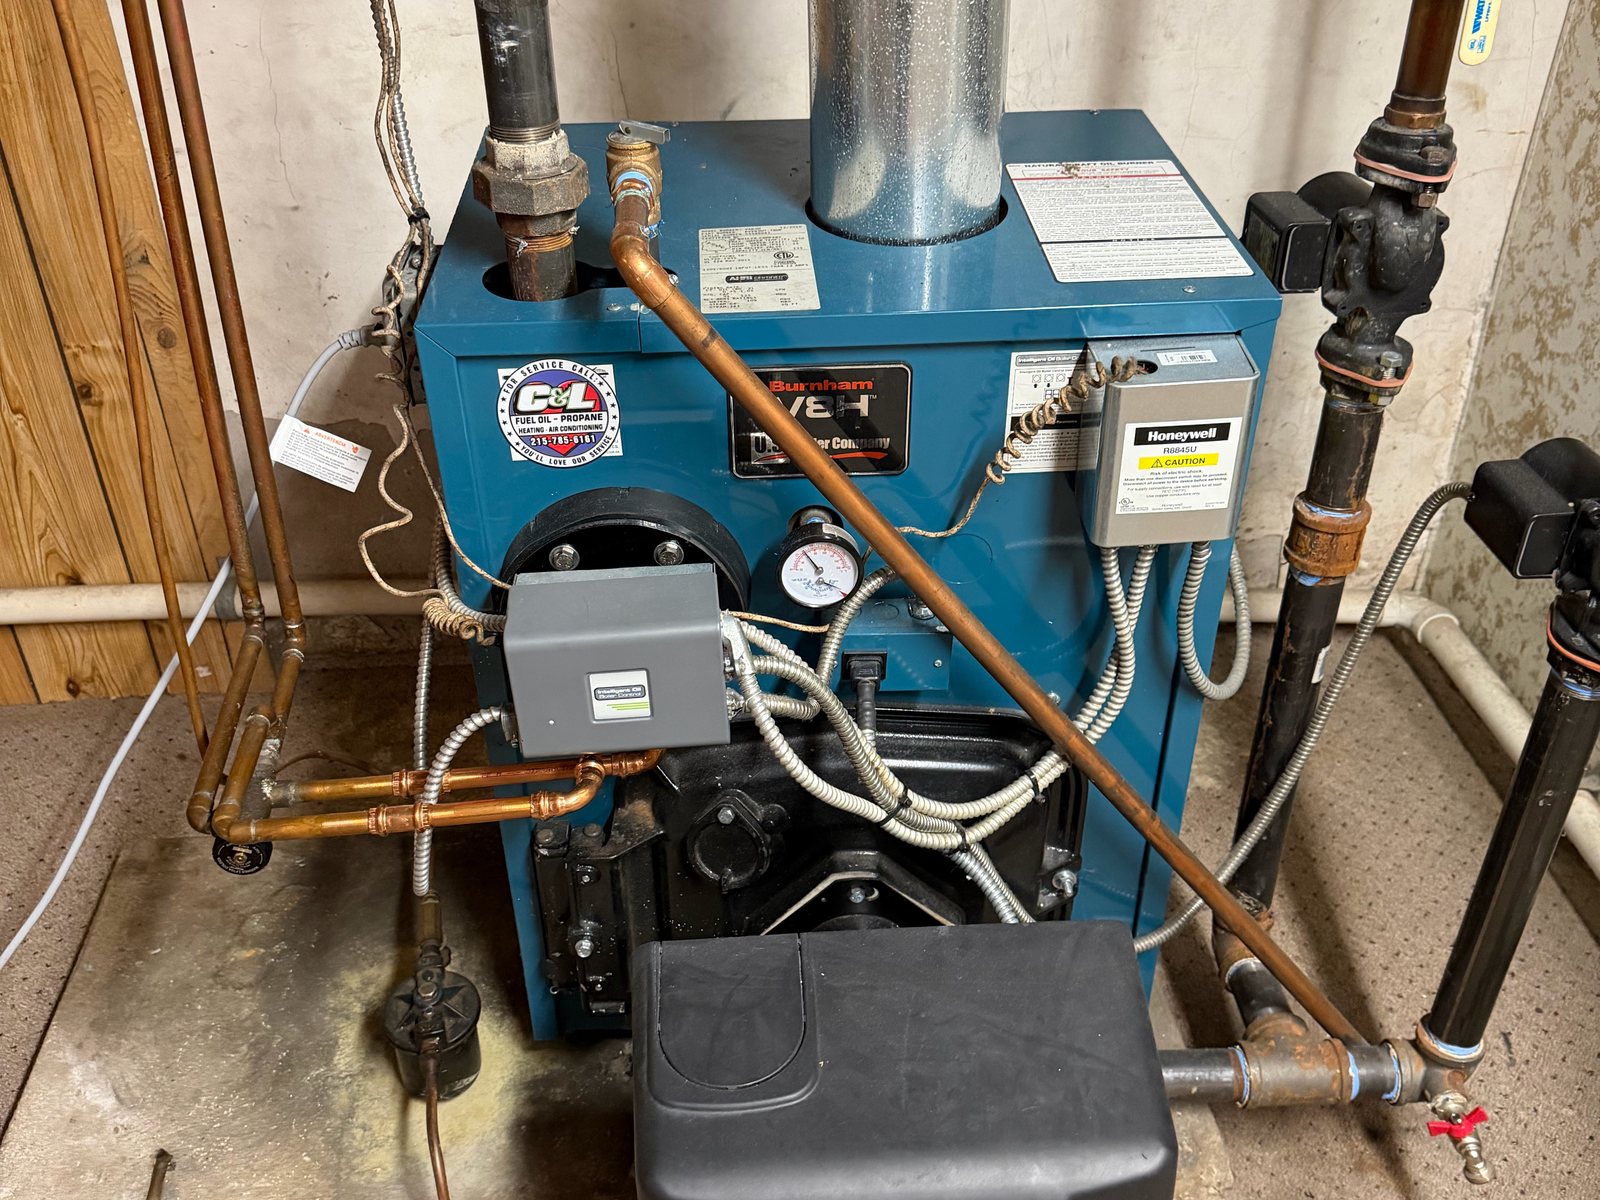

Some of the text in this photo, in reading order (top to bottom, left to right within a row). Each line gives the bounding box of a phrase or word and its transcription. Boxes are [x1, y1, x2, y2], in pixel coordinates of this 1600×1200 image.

[503, 378, 519, 394] FOR
[520, 361, 564, 377] SERVICE
[769, 380, 873, 392] Burnham
[516, 381, 596, 412] C&L
[515, 416, 537, 425] FUEL
[538, 415, 552, 424] OIL
[560, 413, 603, 423] PROPANE
[518, 426, 544, 434] HEATING
[559, 423, 603, 433] CONDITIONING
[1147, 427, 1218, 442] Honeywell
[530, 434, 597, 447] 215-785-6161
[831, 436, 891, 450] Company
[520, 445, 544, 462] YOU'LL
[572, 456, 587, 464] OUR
[589, 435, 613, 458] SERVICE
[1163, 446, 1198, 454] R8845U
[1164, 457, 1206, 466] CAUTION
